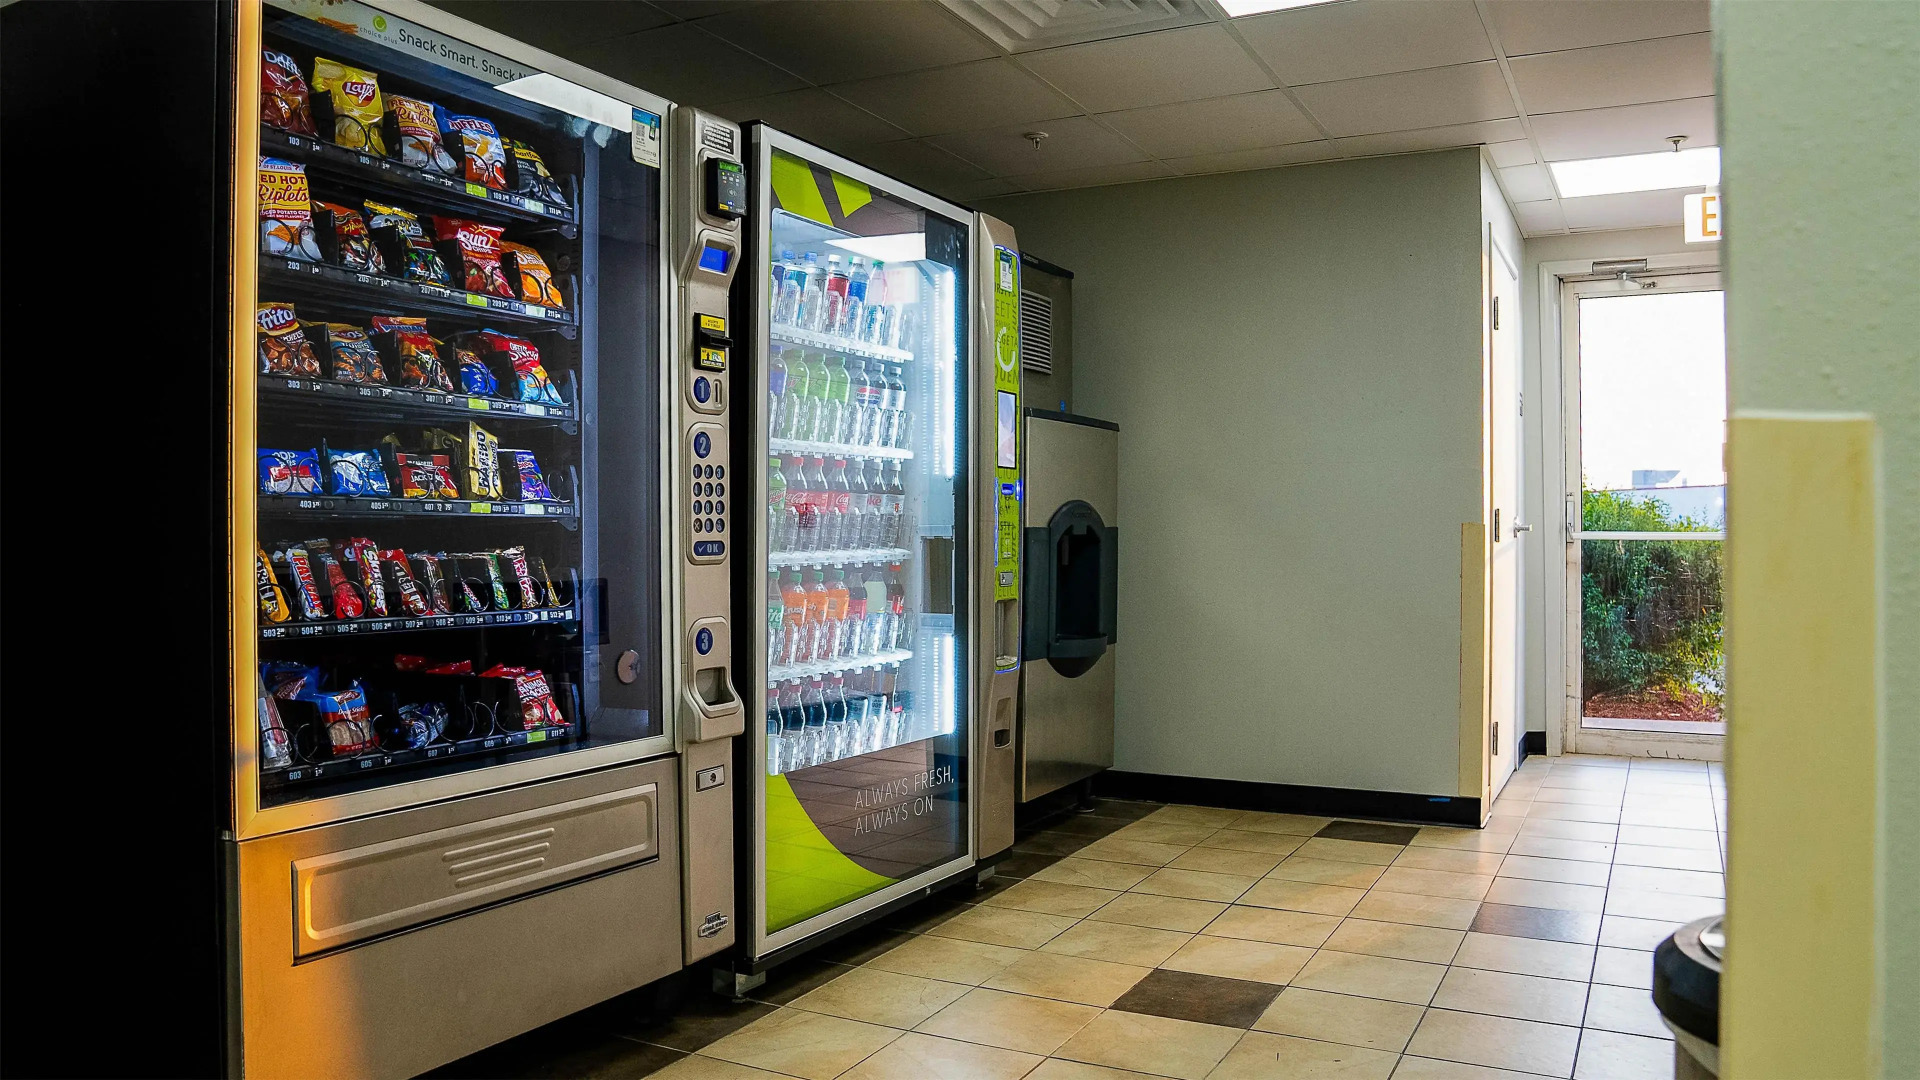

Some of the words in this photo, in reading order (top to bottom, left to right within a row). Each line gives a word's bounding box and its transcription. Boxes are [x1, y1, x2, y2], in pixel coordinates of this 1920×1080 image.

[360, 27, 382, 39] choice
[399, 28, 437, 54] Snack
[440, 44, 478, 69] Smart.
[481, 61, 515, 82] Snack
[289, 136, 300, 146] 103
[360, 156, 370, 165] 105
[259, 174, 277, 184] ED
[280, 176, 306, 185] HOT
[259, 184, 309, 204] Riplets
[1701, 196, 1720, 236] E
[288, 261, 300, 271] 203
[288, 380, 300, 388] 303
[360, 388, 371, 396] 305
[699, 381, 705, 399] 1
[699, 437, 707, 454] 2
[300, 500, 311, 509] 403
[371, 502, 381, 510] 405
[706, 543, 719, 553] OK
[405, 620, 415, 628] 507
[465, 616, 476, 624] 509
[301, 627, 313, 635] 504
[337, 625, 349, 633] 505
[372, 623, 383, 631] 506
[263, 629, 276, 638] 503
[701, 632, 709, 650] 3
[361, 760, 372, 769] 605
[289, 771, 302, 780] 603
[854, 777, 908, 811] ALWAYS
[913, 765, 954, 793] FRESH,
[854, 803, 908, 837] ALWAYS
[913, 795, 934, 816] ON
